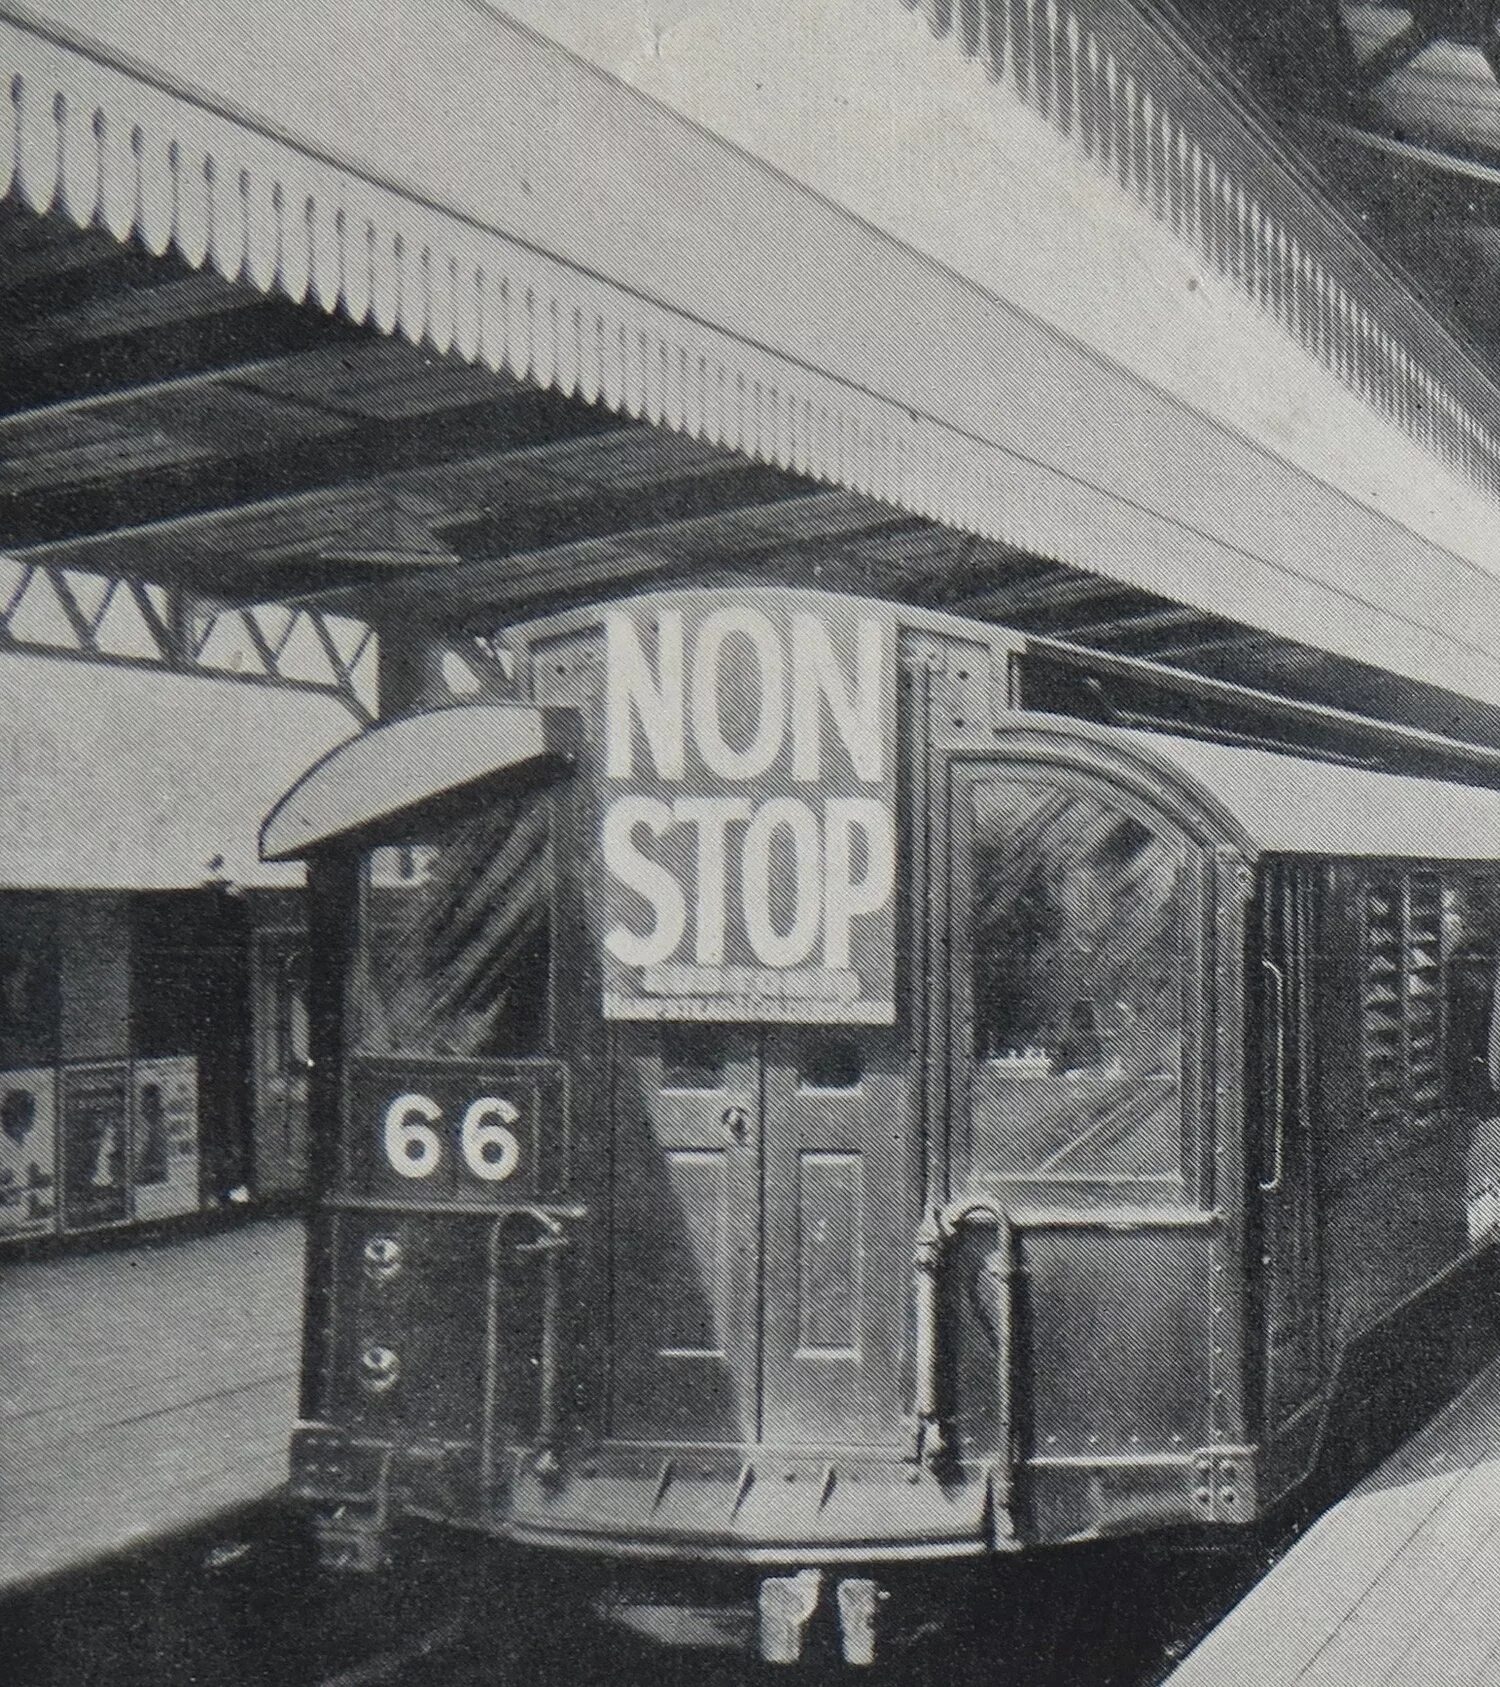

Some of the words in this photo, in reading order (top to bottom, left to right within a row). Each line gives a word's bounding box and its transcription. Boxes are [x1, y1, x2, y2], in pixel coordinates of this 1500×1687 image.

[605, 607, 884, 783] NON
[602, 796, 894, 969] STOP
[383, 1093, 520, 1181] 66
